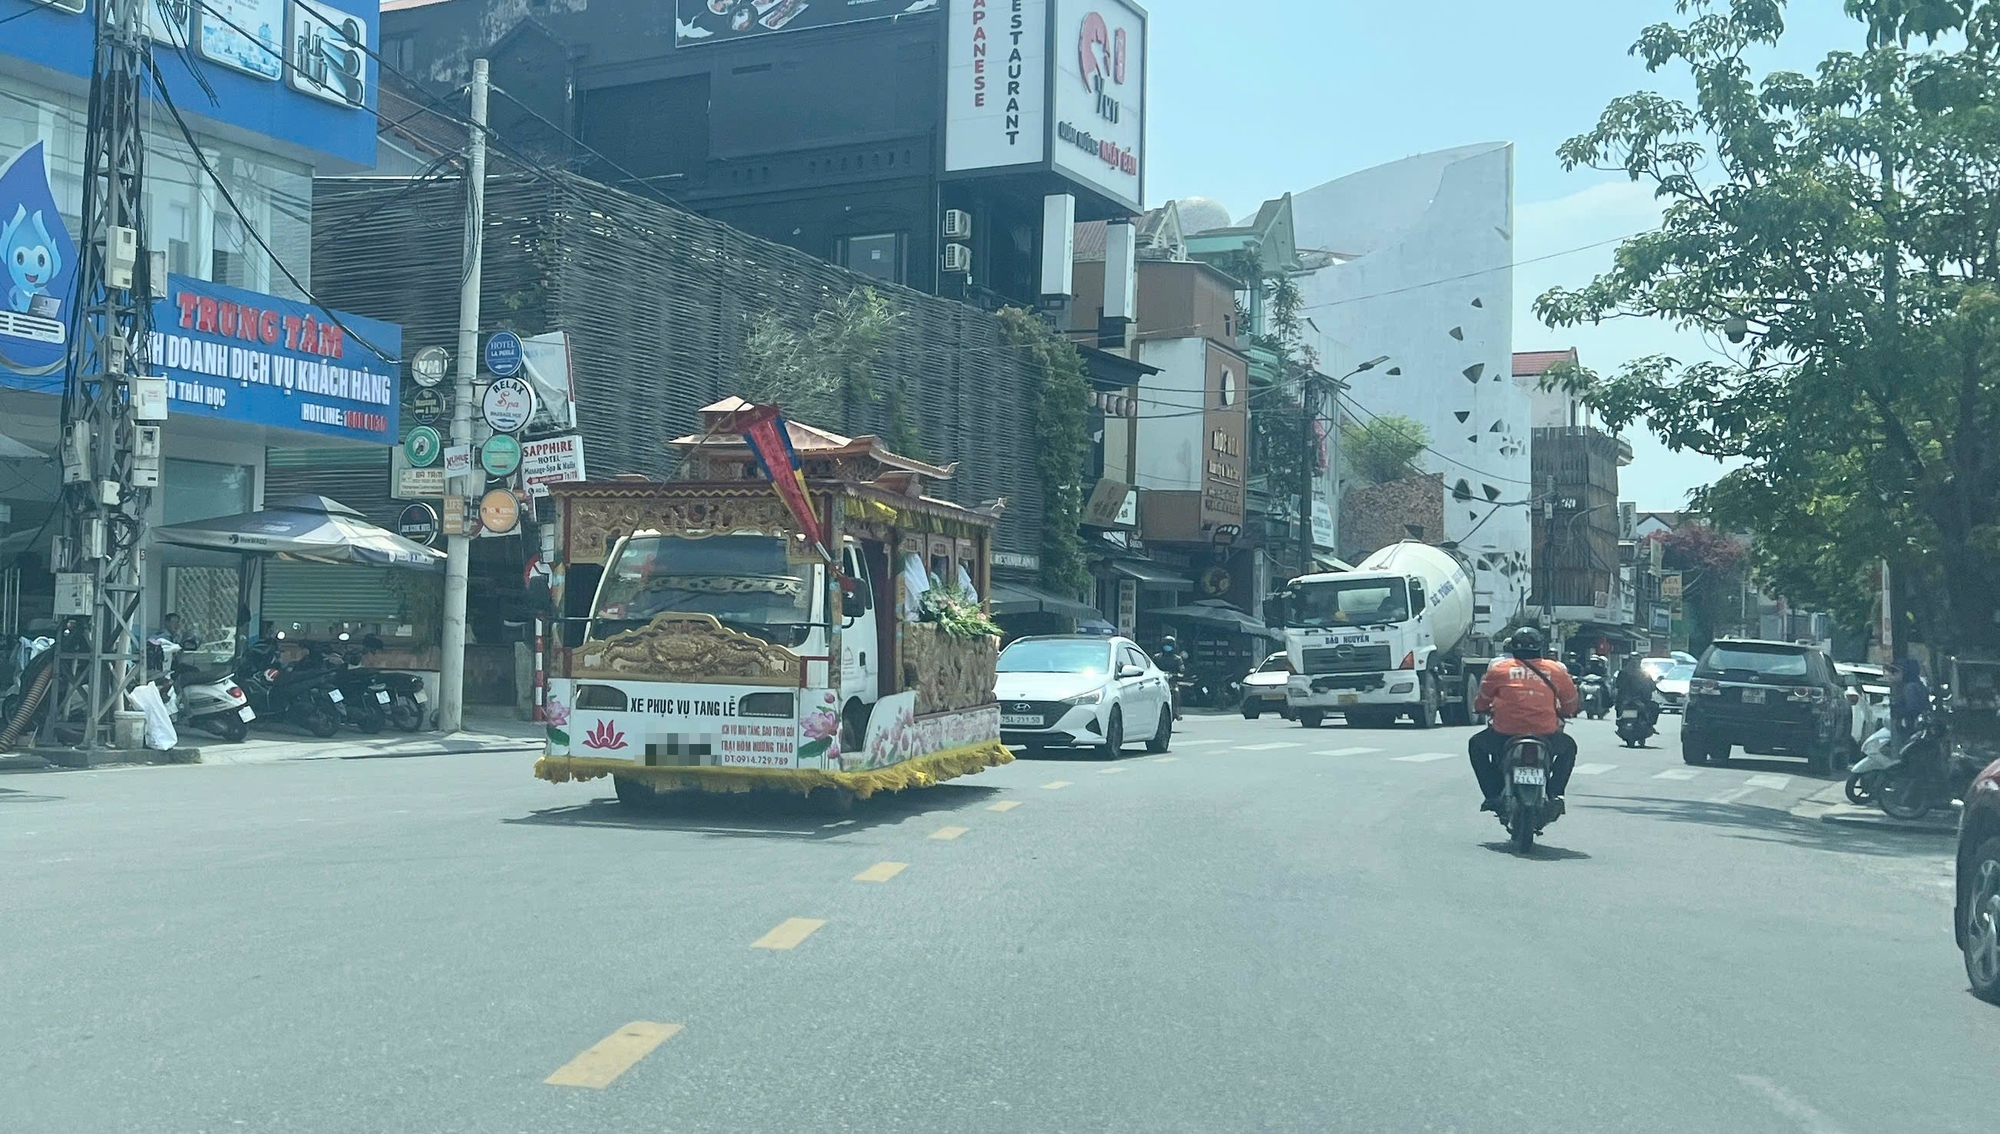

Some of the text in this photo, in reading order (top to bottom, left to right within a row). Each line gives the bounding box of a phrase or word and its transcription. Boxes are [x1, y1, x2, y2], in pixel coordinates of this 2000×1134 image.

[1005, 0, 1023, 145] ESTAURANT
[176, 291, 343, 359] TRUNG TÂM
[490, 340, 516, 350] HOTEL
[166, 335, 228, 377] DOANH
[231, 347, 269, 388] DỊCH
[272, 355, 295, 396] VỤ
[298, 358, 348, 398] KHÁCH
[351, 366, 391, 405] HÀNG
[177, 380, 203, 402] THÁI
[206, 386, 226, 410] HỌC
[492, 380, 525, 395] RELAX
[494, 390, 519, 411] Spa
[522, 440, 573, 458] SAPPHIRE
[537, 455, 560, 464] HOTEL
[630, 695, 736, 719] XE PHỤC VỤ TANG LỄ
